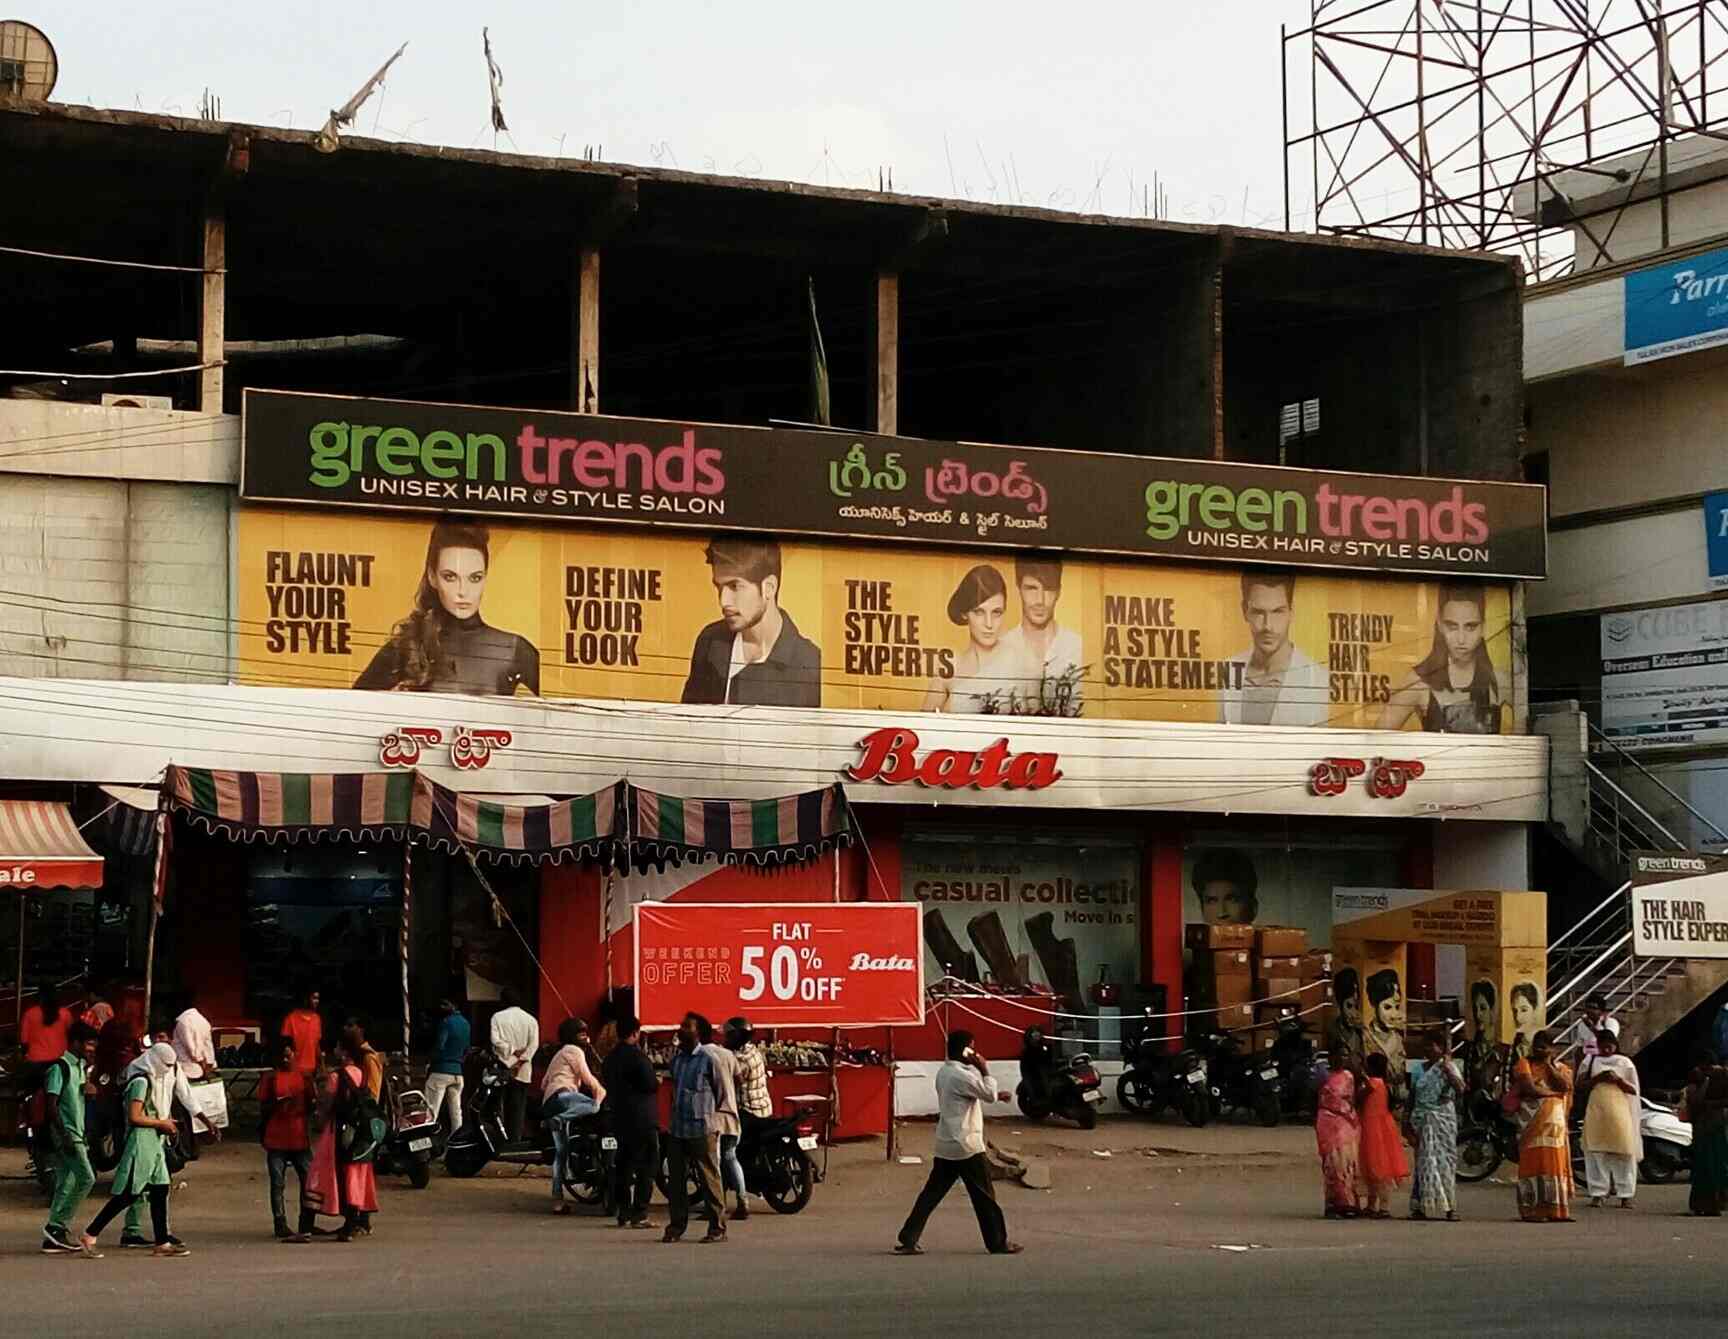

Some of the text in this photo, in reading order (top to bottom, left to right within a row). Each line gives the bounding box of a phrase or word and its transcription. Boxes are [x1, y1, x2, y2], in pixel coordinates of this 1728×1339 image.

[1670, 270, 1728, 304] Parr
[309, 420, 726, 495] green trends
[829, 443, 1048, 513] గ్రీన్ ట్రెండ్స్
[360, 478, 459, 498] UNISEX
[465, 484, 527, 503] HAIR
[552, 489, 632, 510] STYLE
[640, 494, 726, 515] SALON
[1145, 480, 1489, 545] green trends
[959, 513, 970, 526] &
[1187, 531, 1269, 551] UNISEX
[1273, 536, 1325, 554] HAIR
[1345, 541, 1412, 559] STYLE
[1417, 546, 1489, 562] SALON
[266, 551, 375, 587] FLAUNT
[565, 566, 663, 601] DEFINE
[266, 586, 346, 620] YOUR
[844, 579, 893, 612] THE
[1104, 595, 1176, 627] MAKE
[565, 600, 643, 634] YOUR
[844, 612, 920, 645] STYLE
[1328, 613, 1395, 644] TRENDY
[266, 620, 353, 655] STYLE
[565, 633, 640, 667] LOOK
[1104, 628, 1200, 659] A STYLE
[844, 644, 955, 679] EXPERTS
[1329, 643, 1370, 673] HAIR
[1104, 658, 1248, 691] STATEMENT
[1329, 672, 1392, 704] STYLES
[845, 727, 1063, 790] Bata
[1638, 857, 1706, 871] green trends
[913, 876, 1010, 904] casual
[1064, 909, 1104, 924] Move
[1107, 909, 1122, 924] in
[1641, 899, 1706, 921] THE HAIR
[772, 923, 812, 940] FLAT
[1642, 920, 1684, 940] STYLE
[642, 947, 730, 959] WEEKEND
[848, 952, 916, 972] Bata
[643, 962, 731, 985] OFFER
